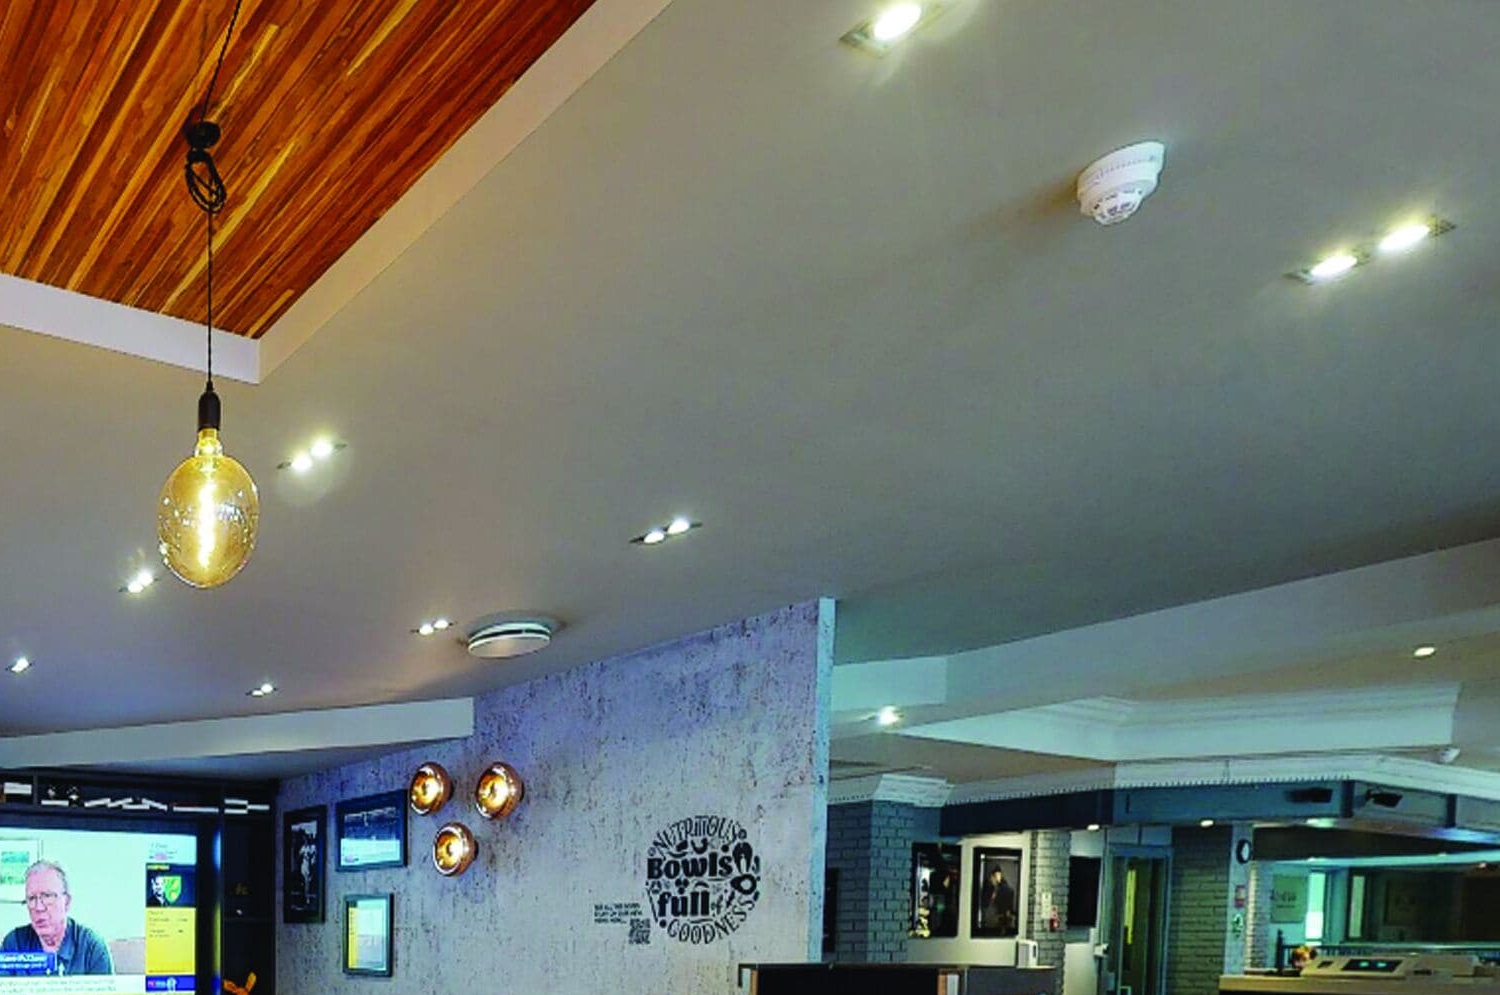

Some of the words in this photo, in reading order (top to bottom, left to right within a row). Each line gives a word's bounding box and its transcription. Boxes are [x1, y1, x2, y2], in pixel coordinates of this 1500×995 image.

[653, 815, 741, 858] NUTRITIOUS
[647, 852, 733, 880] Bowls
[657, 890, 710, 918] full
[667, 899, 756, 945] GOODNESS
